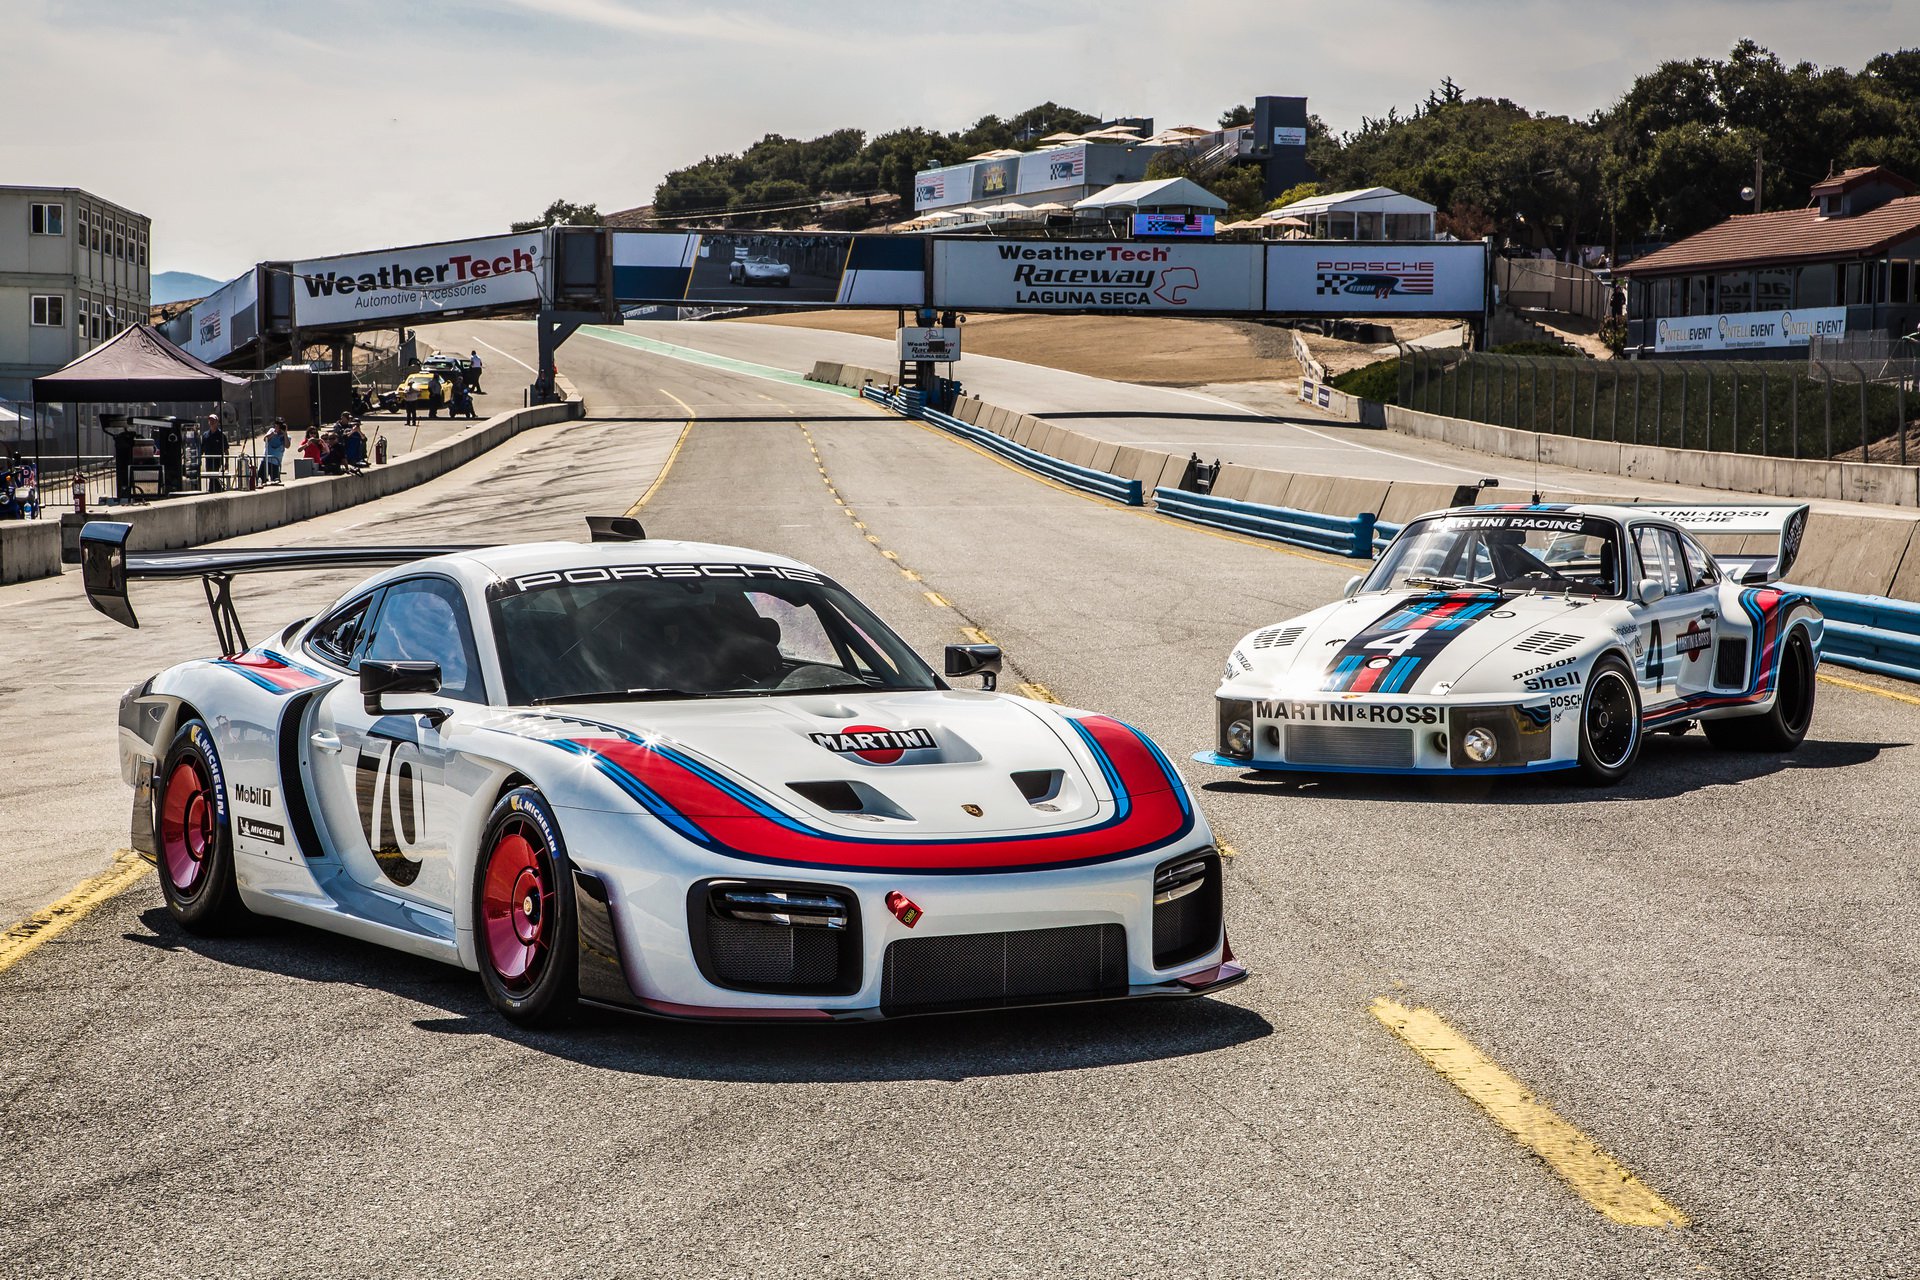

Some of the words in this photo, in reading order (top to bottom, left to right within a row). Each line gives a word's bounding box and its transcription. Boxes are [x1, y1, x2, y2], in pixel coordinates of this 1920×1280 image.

[1013, 264, 1156, 288] Raceway
[1317, 261, 1434, 271] PORSCHE
[354, 291, 417, 310] Automotive
[420, 282, 487, 301] Accessories
[1016, 291, 1097, 305] LAGUNA
[1100, 292, 1152, 305] SECA
[1429, 517, 1506, 531] MARTINI
[1510, 518, 1584, 531] RACING
[514, 565, 825, 592] PORSCHE
[1363, 629, 1429, 656] 4
[1512, 656, 1577, 680] DUNLOP
[1646, 619, 1664, 693] 4
[1523, 671, 1581, 690] Shell
[1550, 694, 1583, 708] BOSCH
[814, 729, 932, 751] MARTINI
[201, 738, 225, 816] MICHELIN
[235, 783, 261, 805] Mobil
[360, 739, 425, 863] 70
[251, 825, 281, 839] MICHELIN
[523, 800, 557, 852] MICHELIN
